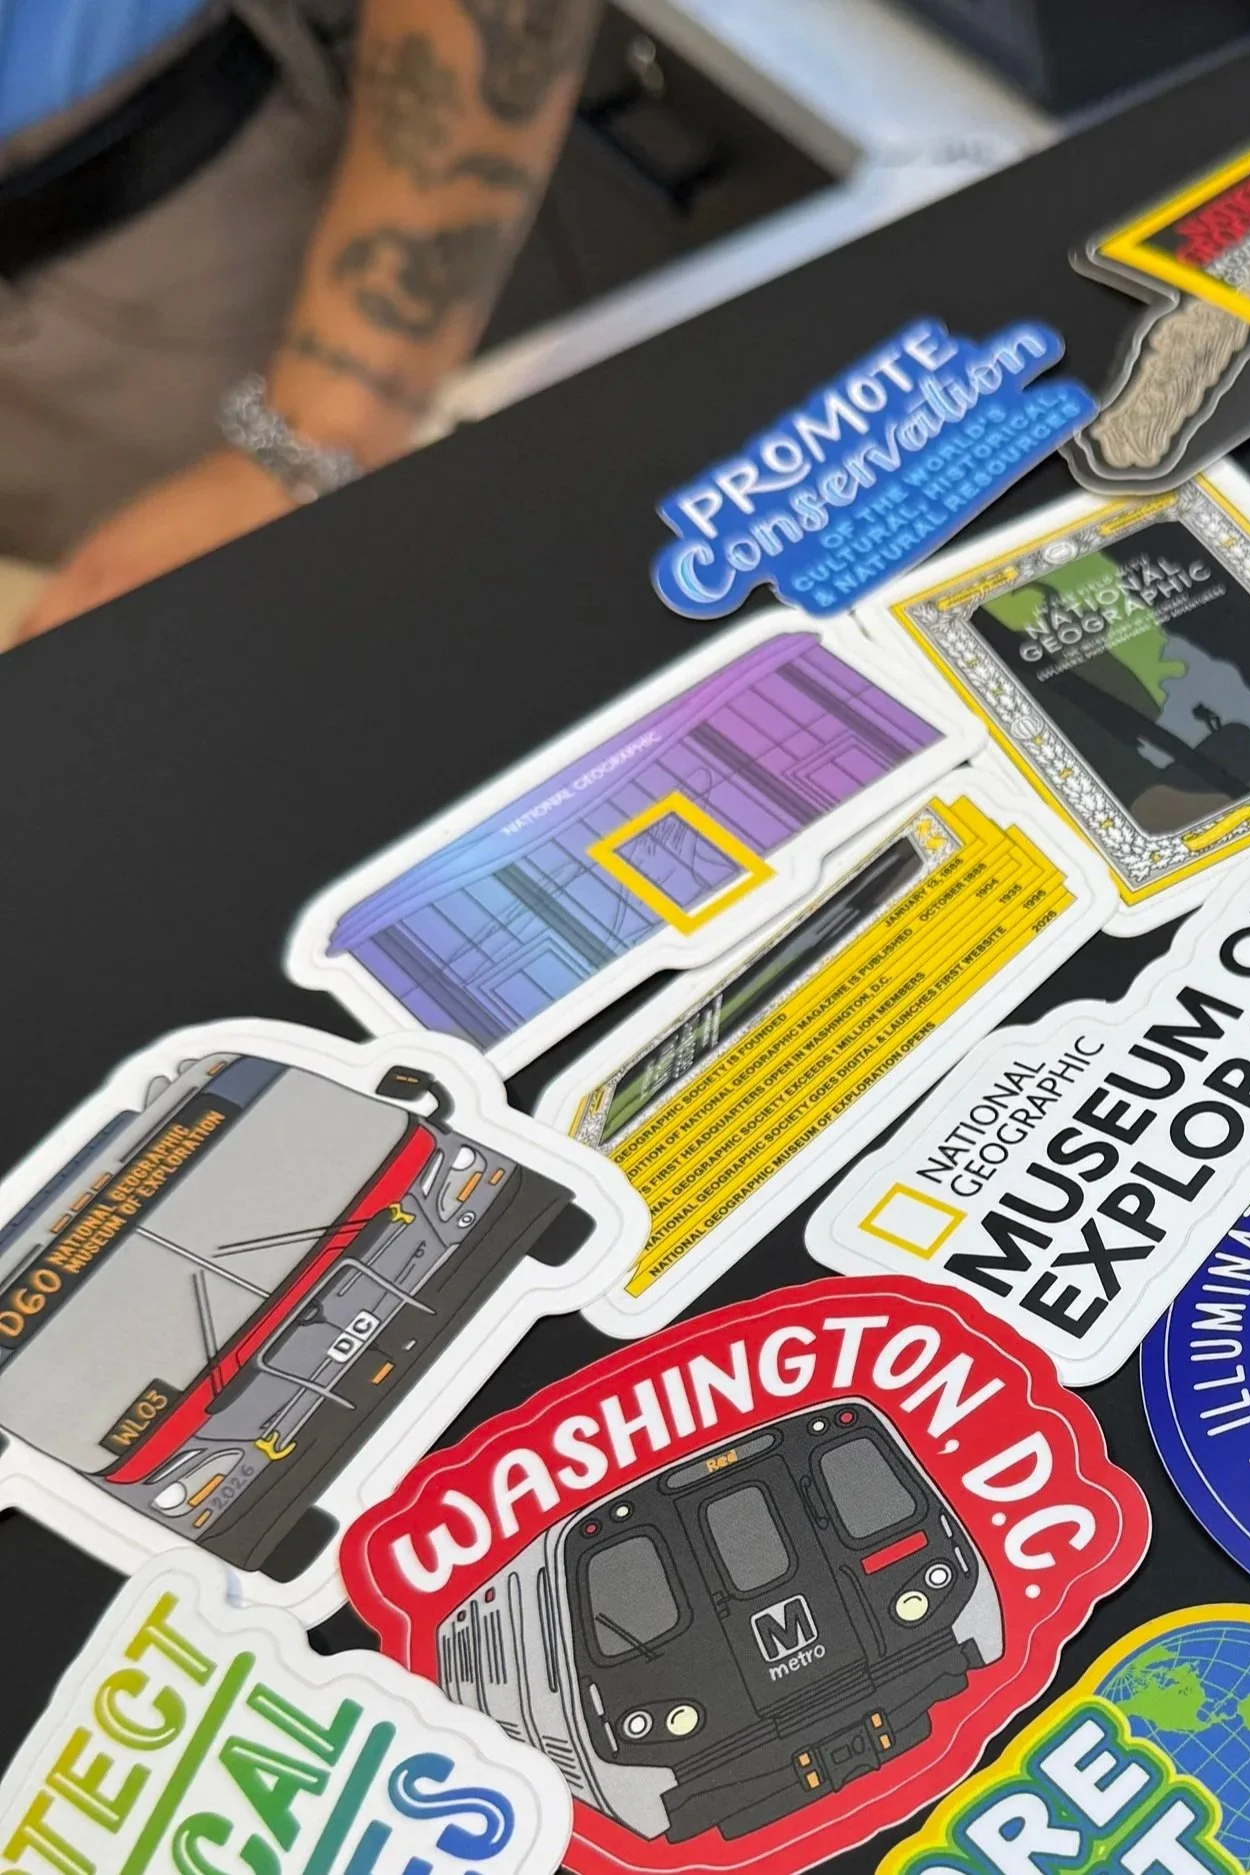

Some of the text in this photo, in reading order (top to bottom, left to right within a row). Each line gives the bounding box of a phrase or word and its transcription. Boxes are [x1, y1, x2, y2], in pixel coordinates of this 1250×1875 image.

[673, 331, 1047, 603] Conservation
[678, 329, 959, 539] PROMOTE
[792, 391, 1070, 591] CULTURAL, HISTORICAL,
[813, 403, 1080, 607] & NATURAL RESOURCES
[820, 404, 1006, 549] OF THE WORLD'S
[1019, 561, 1211, 662] GEOGRAPHIC
[1025, 557, 1181, 640] NATIONAL
[501, 730, 663, 837] NATIONAL GEOGRAPHIC
[614, 1103, 684, 1164] GEOGRAPHIC
[682, 1062, 728, 1106] SOCIETY
[726, 1054, 740, 1067] IS
[738, 1012, 787, 1058] FOUNDED
[884, 887, 928, 928] JANUARY
[644, 1202, 698, 1251] NATIONAL
[696, 1140, 766, 1203] GEOGRAPHIC
[764, 1102, 810, 1142] SOCIETY
[808, 1076, 840, 1103] GOES
[837, 1043, 879, 1078] DIGITAL
[876, 1033, 888, 1044] &
[883, 988, 937, 1036] LAUNCHES
[934, 963, 964, 992] FIRST
[961, 925, 1007, 965] WEBSITE
[648, 909, 1059, 1278] NATIONAL GEOGRAPHIC MUSEUM OF EXPLORATION OPENS 2026
[651, 1158, 682, 1187] FIRST
[680, 1086, 766, 1160] HEADQUARTERS
[764, 1059, 793, 1088] OPEN
[791, 1051, 806, 1064] IN
[803, 993, 874, 1053] WASHINGTON,
[870, 974, 893, 993] D.C.
[975, 878, 999, 899] 1904
[665, 1130, 682, 1145] OF
[679, 1086, 735, 1133] NATIONAL
[732, 1029, 800, 1087] GEOGRAPHIC
[798, 983, 850, 1031] MAGAZINE
[849, 975, 862, 986] IS
[858, 928, 913, 977] PUBLISHED
[919, 881, 966, 922] OCTOBER
[672, 1134, 742, 1197] GEOGRAPHIC
[740, 1096, 785, 1136] SOCIETY
[783, 1055, 833, 1097] EXCEEDS
[836, 1013, 879, 1051] MILLION
[876, 971, 926, 1015] MEMBERS
[998, 884, 1023, 904] 1935
[47, 1123, 190, 1265] NATIONAL GEOGRAPHIC
[63, 1109, 227, 1275] MUSEUM OF EXPLORATION
[916, 1058, 1049, 1187] NATIONAL
[943, 985, 1246, 1299] MUSEUM
[950, 1034, 1106, 1199] GEOGRAPHIC
[0, 1268, 62, 1337] D60
[210, 1464, 256, 1512] 2026
[388, 1313, 1098, 1600] WASHINGTON, D.C.
[705, 1449, 738, 1473] Red
[0, 1591, 218, 1875] TECT
[768, 1644, 826, 1682] metro
[919, 1719, 1150, 1875] RE
